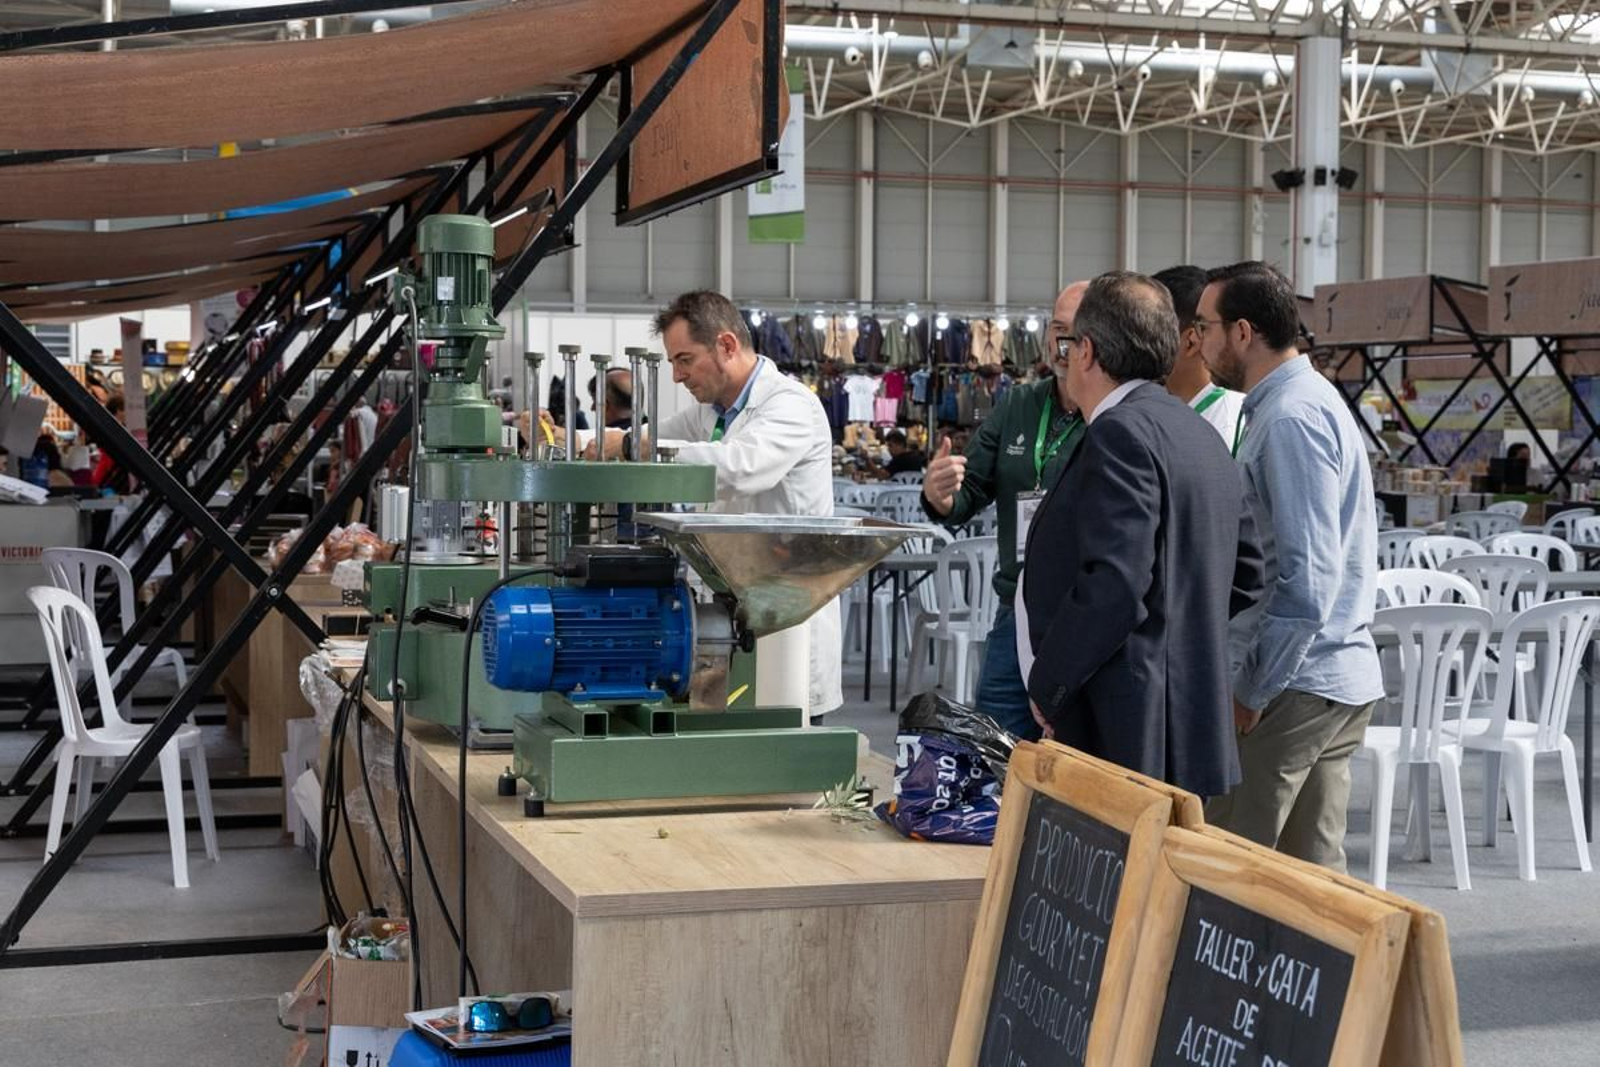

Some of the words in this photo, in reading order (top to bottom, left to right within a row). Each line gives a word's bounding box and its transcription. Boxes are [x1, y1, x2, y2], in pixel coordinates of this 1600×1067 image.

[1019, 892, 1104, 999] GOURMET
[1195, 918, 1254, 984] TALLER
[1268, 953, 1320, 1018] CATA
[1232, 998, 1259, 1039] DE
